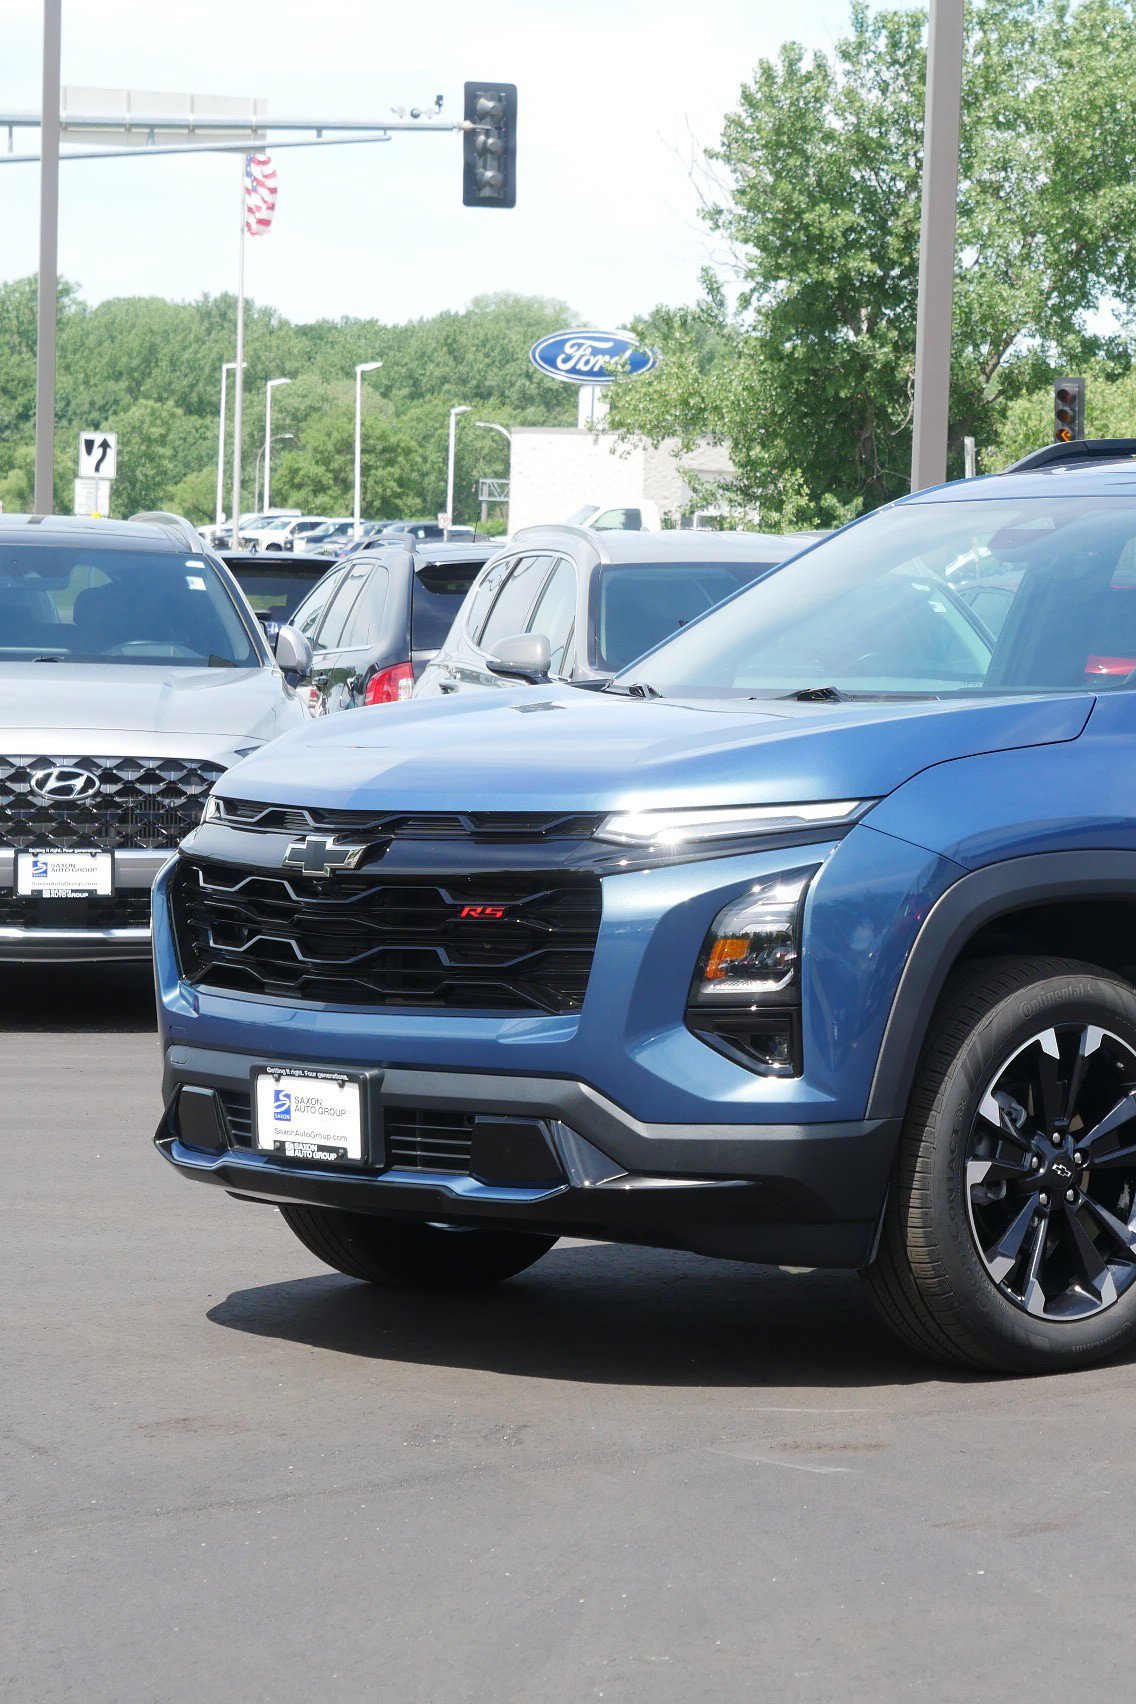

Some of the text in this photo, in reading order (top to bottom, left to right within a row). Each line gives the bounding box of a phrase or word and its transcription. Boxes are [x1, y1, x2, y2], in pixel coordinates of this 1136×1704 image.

[460, 905, 507, 918] RS
[266, 1067, 286, 1076] Getting
[294, 1096, 323, 1106] SAXON
[294, 1105, 346, 1117] AUTO GROUP
[274, 1127, 348, 1141] SaxonAutoGroup.com
[294, 1142, 318, 1152] SAXON
[294, 1150, 337, 1161] AUTO GROUP
